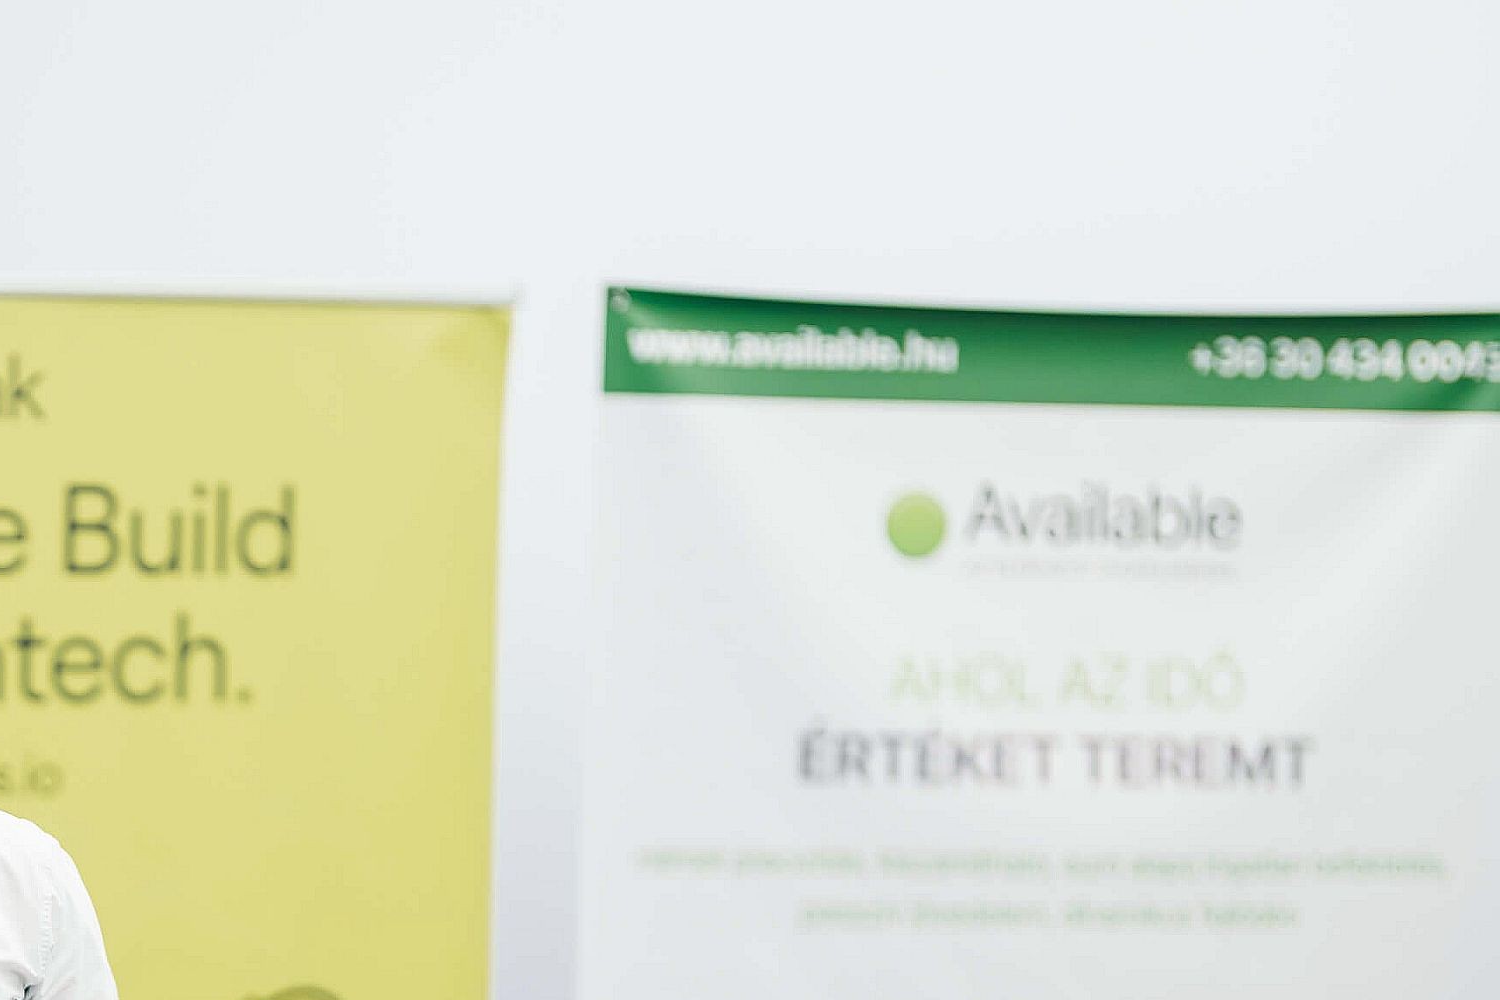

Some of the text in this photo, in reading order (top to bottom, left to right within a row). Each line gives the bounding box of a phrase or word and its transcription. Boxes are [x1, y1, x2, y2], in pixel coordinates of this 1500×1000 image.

[1189, 334, 1268, 379] +36
[1269, 336, 1324, 381] 30
[63, 482, 297, 576] Build
[963, 479, 1246, 550] Available
[891, 652, 1041, 712] AHOL
[1055, 652, 1131, 712] AZ
[797, 716, 1316, 790] ÉRTÉKET TEREMT
